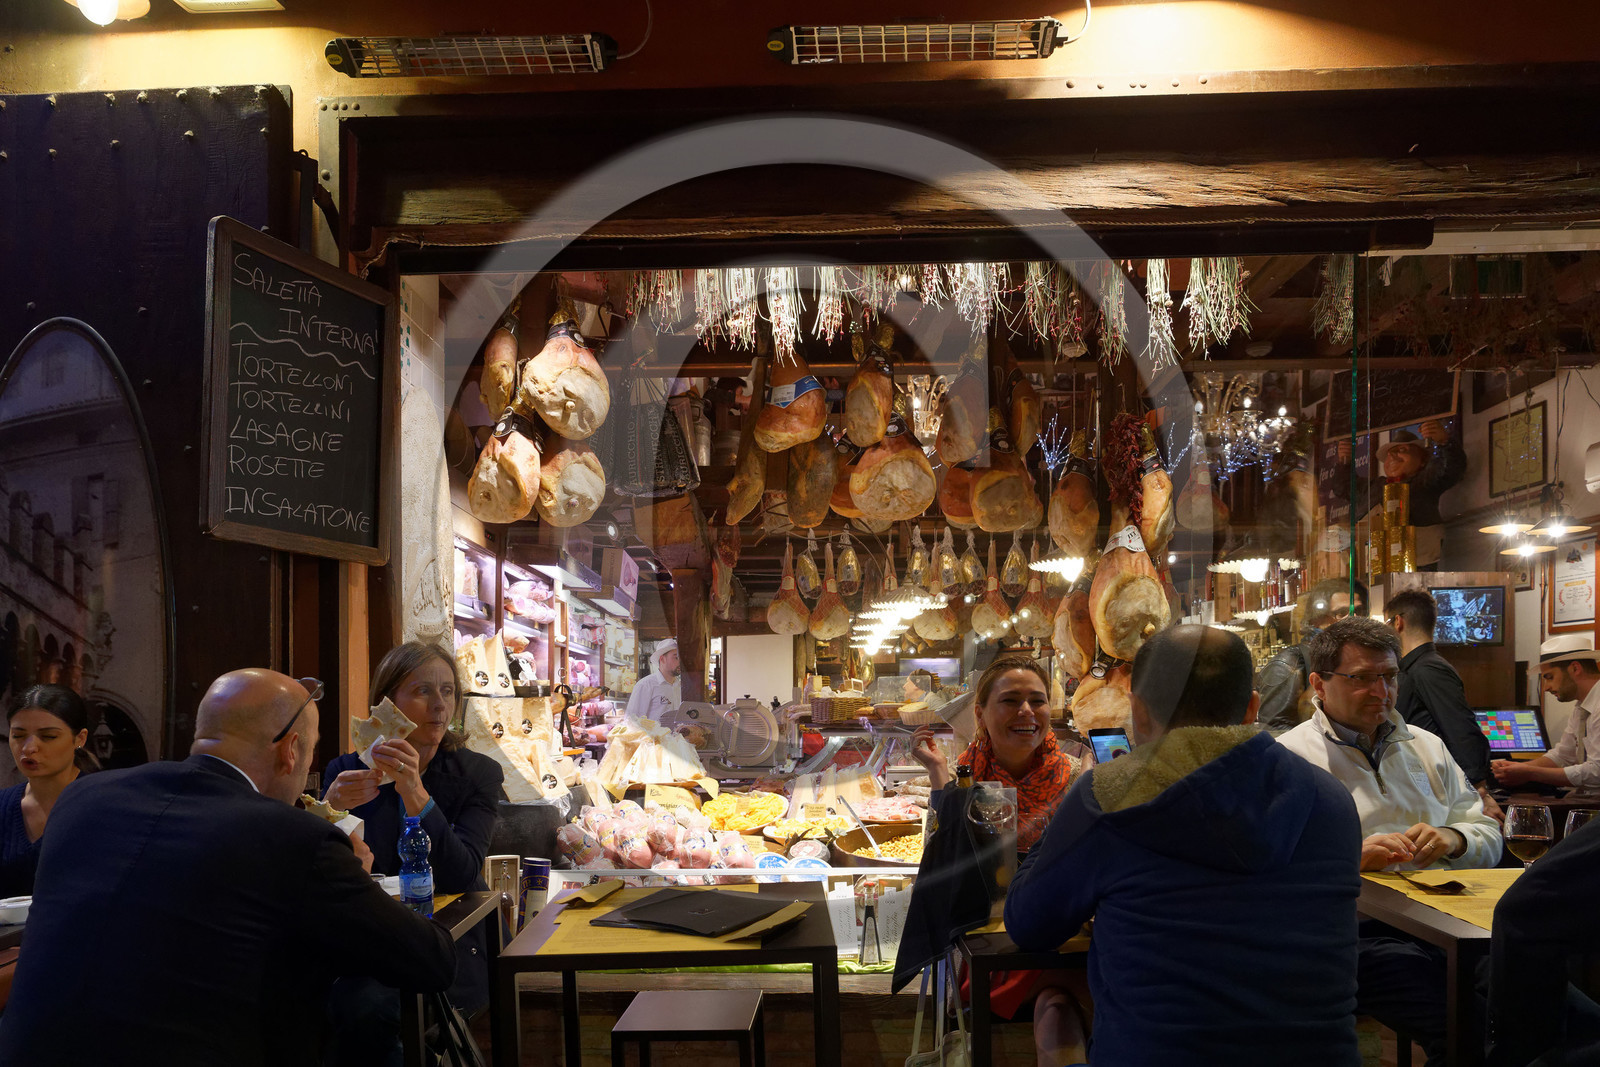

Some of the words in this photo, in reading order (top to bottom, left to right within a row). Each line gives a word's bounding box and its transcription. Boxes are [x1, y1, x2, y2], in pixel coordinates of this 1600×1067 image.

[233, 253, 322, 307] SALETTA
[231, 339, 353, 395] TORTELLONI
[229, 380, 351, 423] TORTELLINI
[229, 415, 344, 452] LASAGNE
[627, 421, 638, 486] AURICCHIO
[228, 445, 326, 479] ROSETTE
[225, 486, 371, 532] INSALATONE
